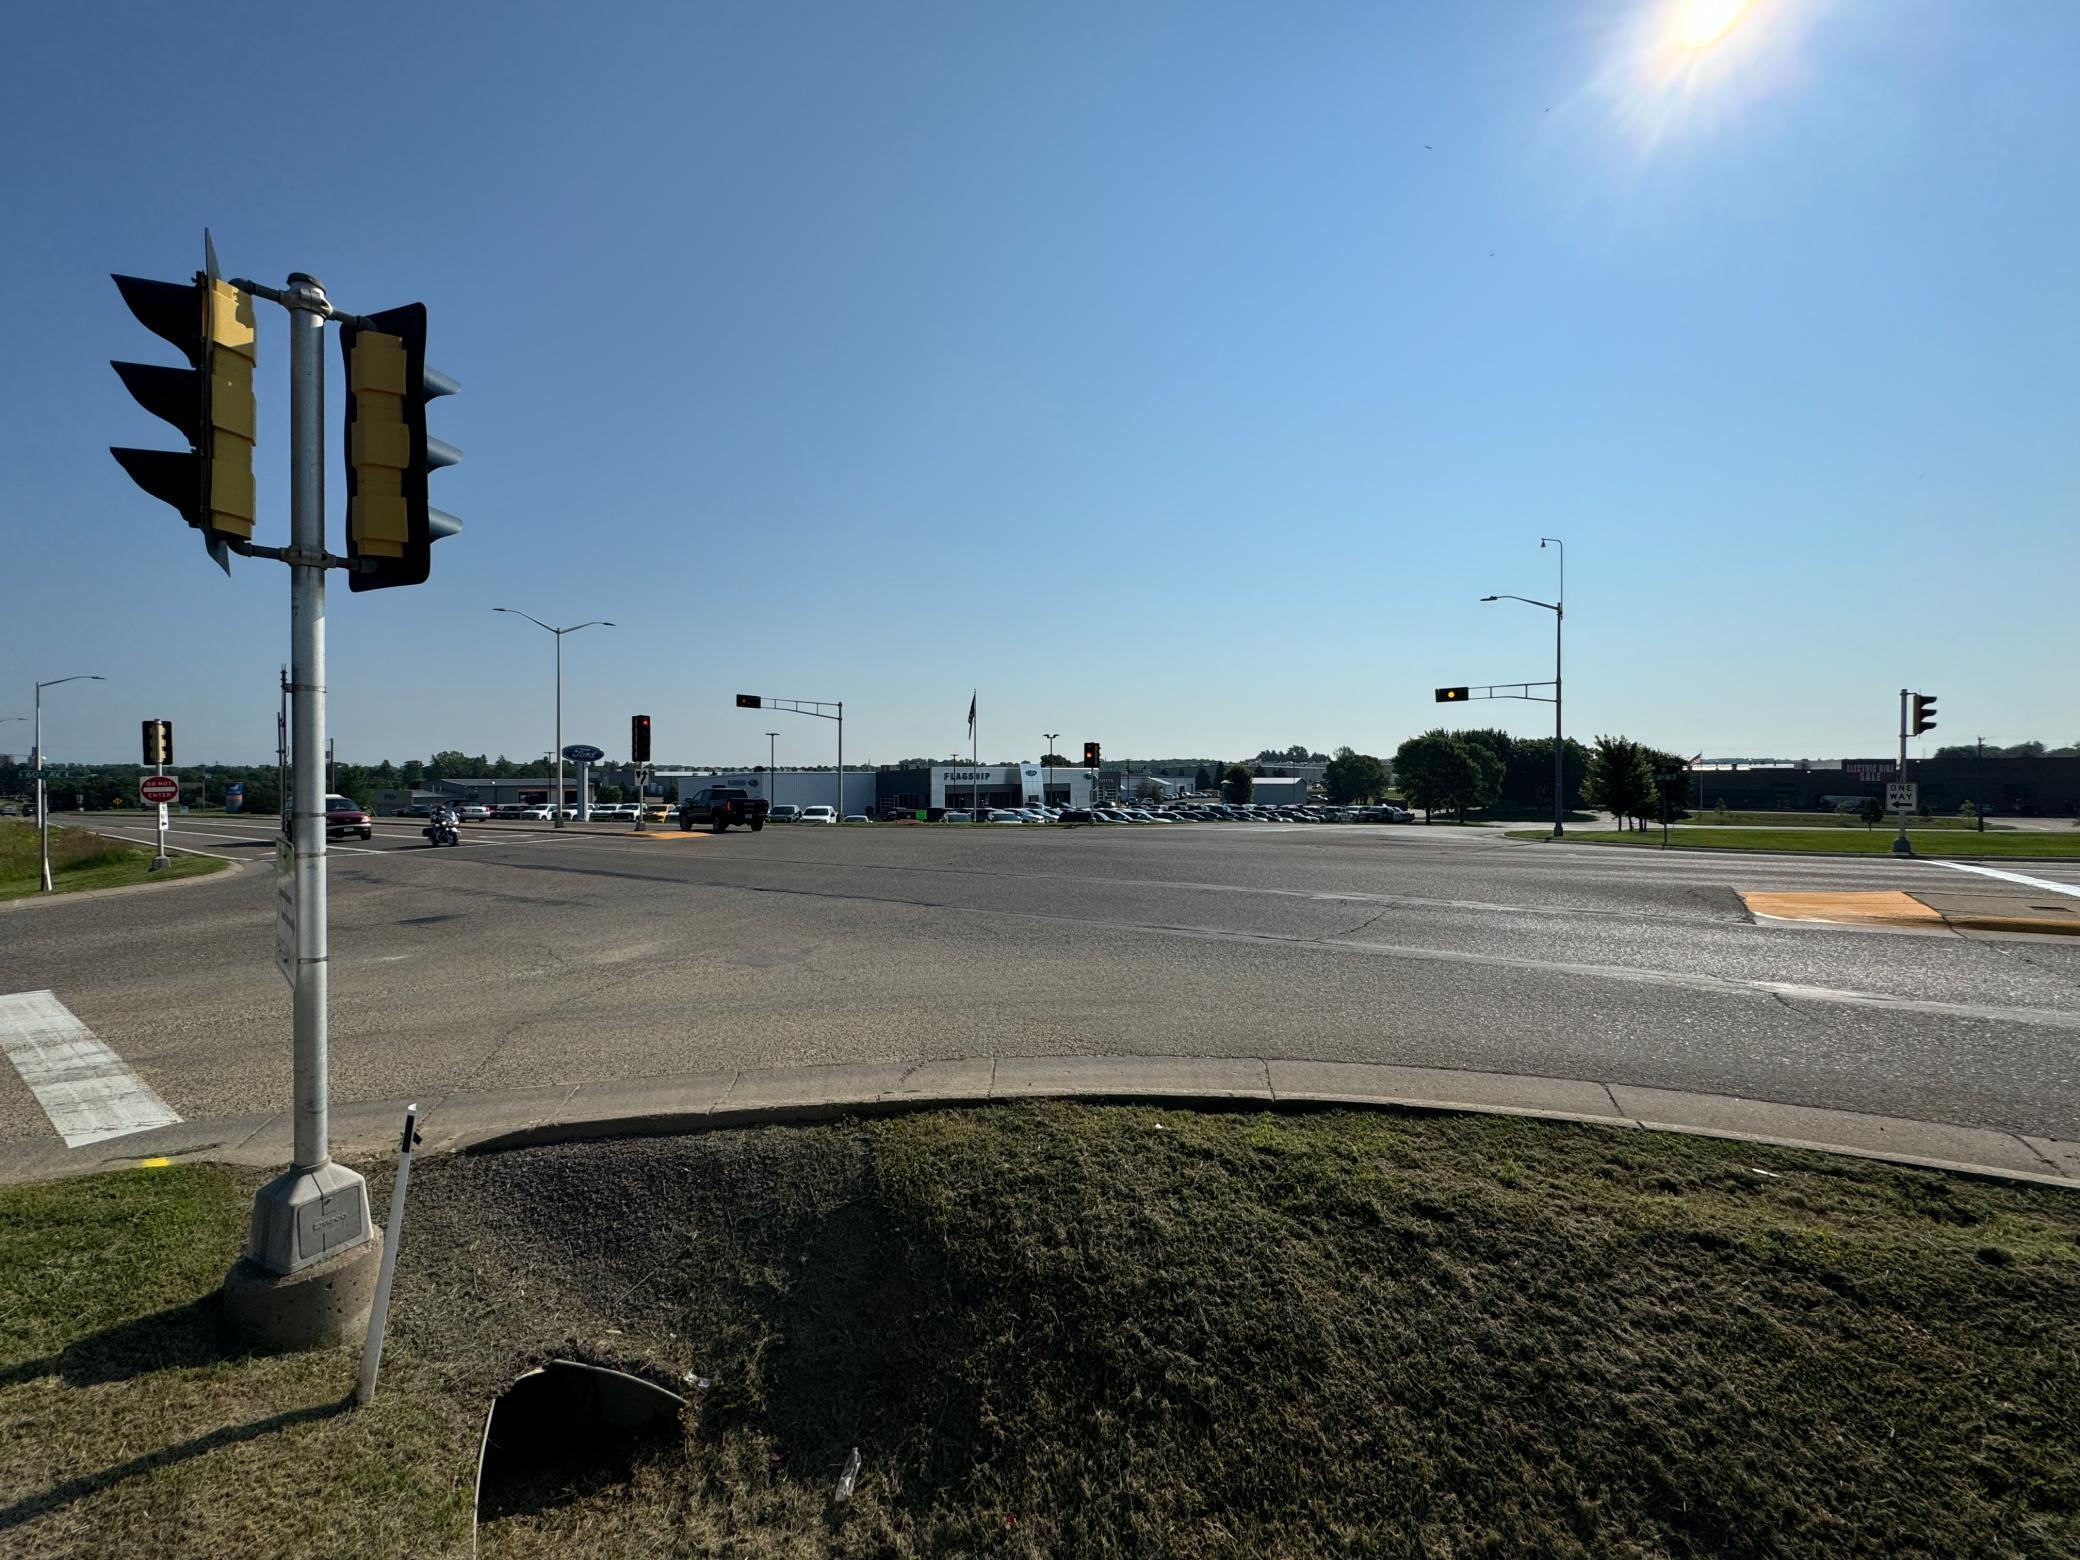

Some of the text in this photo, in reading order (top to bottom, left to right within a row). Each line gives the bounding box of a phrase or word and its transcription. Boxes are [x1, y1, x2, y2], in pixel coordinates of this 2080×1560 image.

[572, 748, 597, 759] Ford
[1846, 763, 1895, 773] ELECTRIC BIKE
[944, 772, 991, 781] FLAGSHIP
[1859, 772, 1881, 781] SALE
[1890, 784, 1913, 792] ONE
